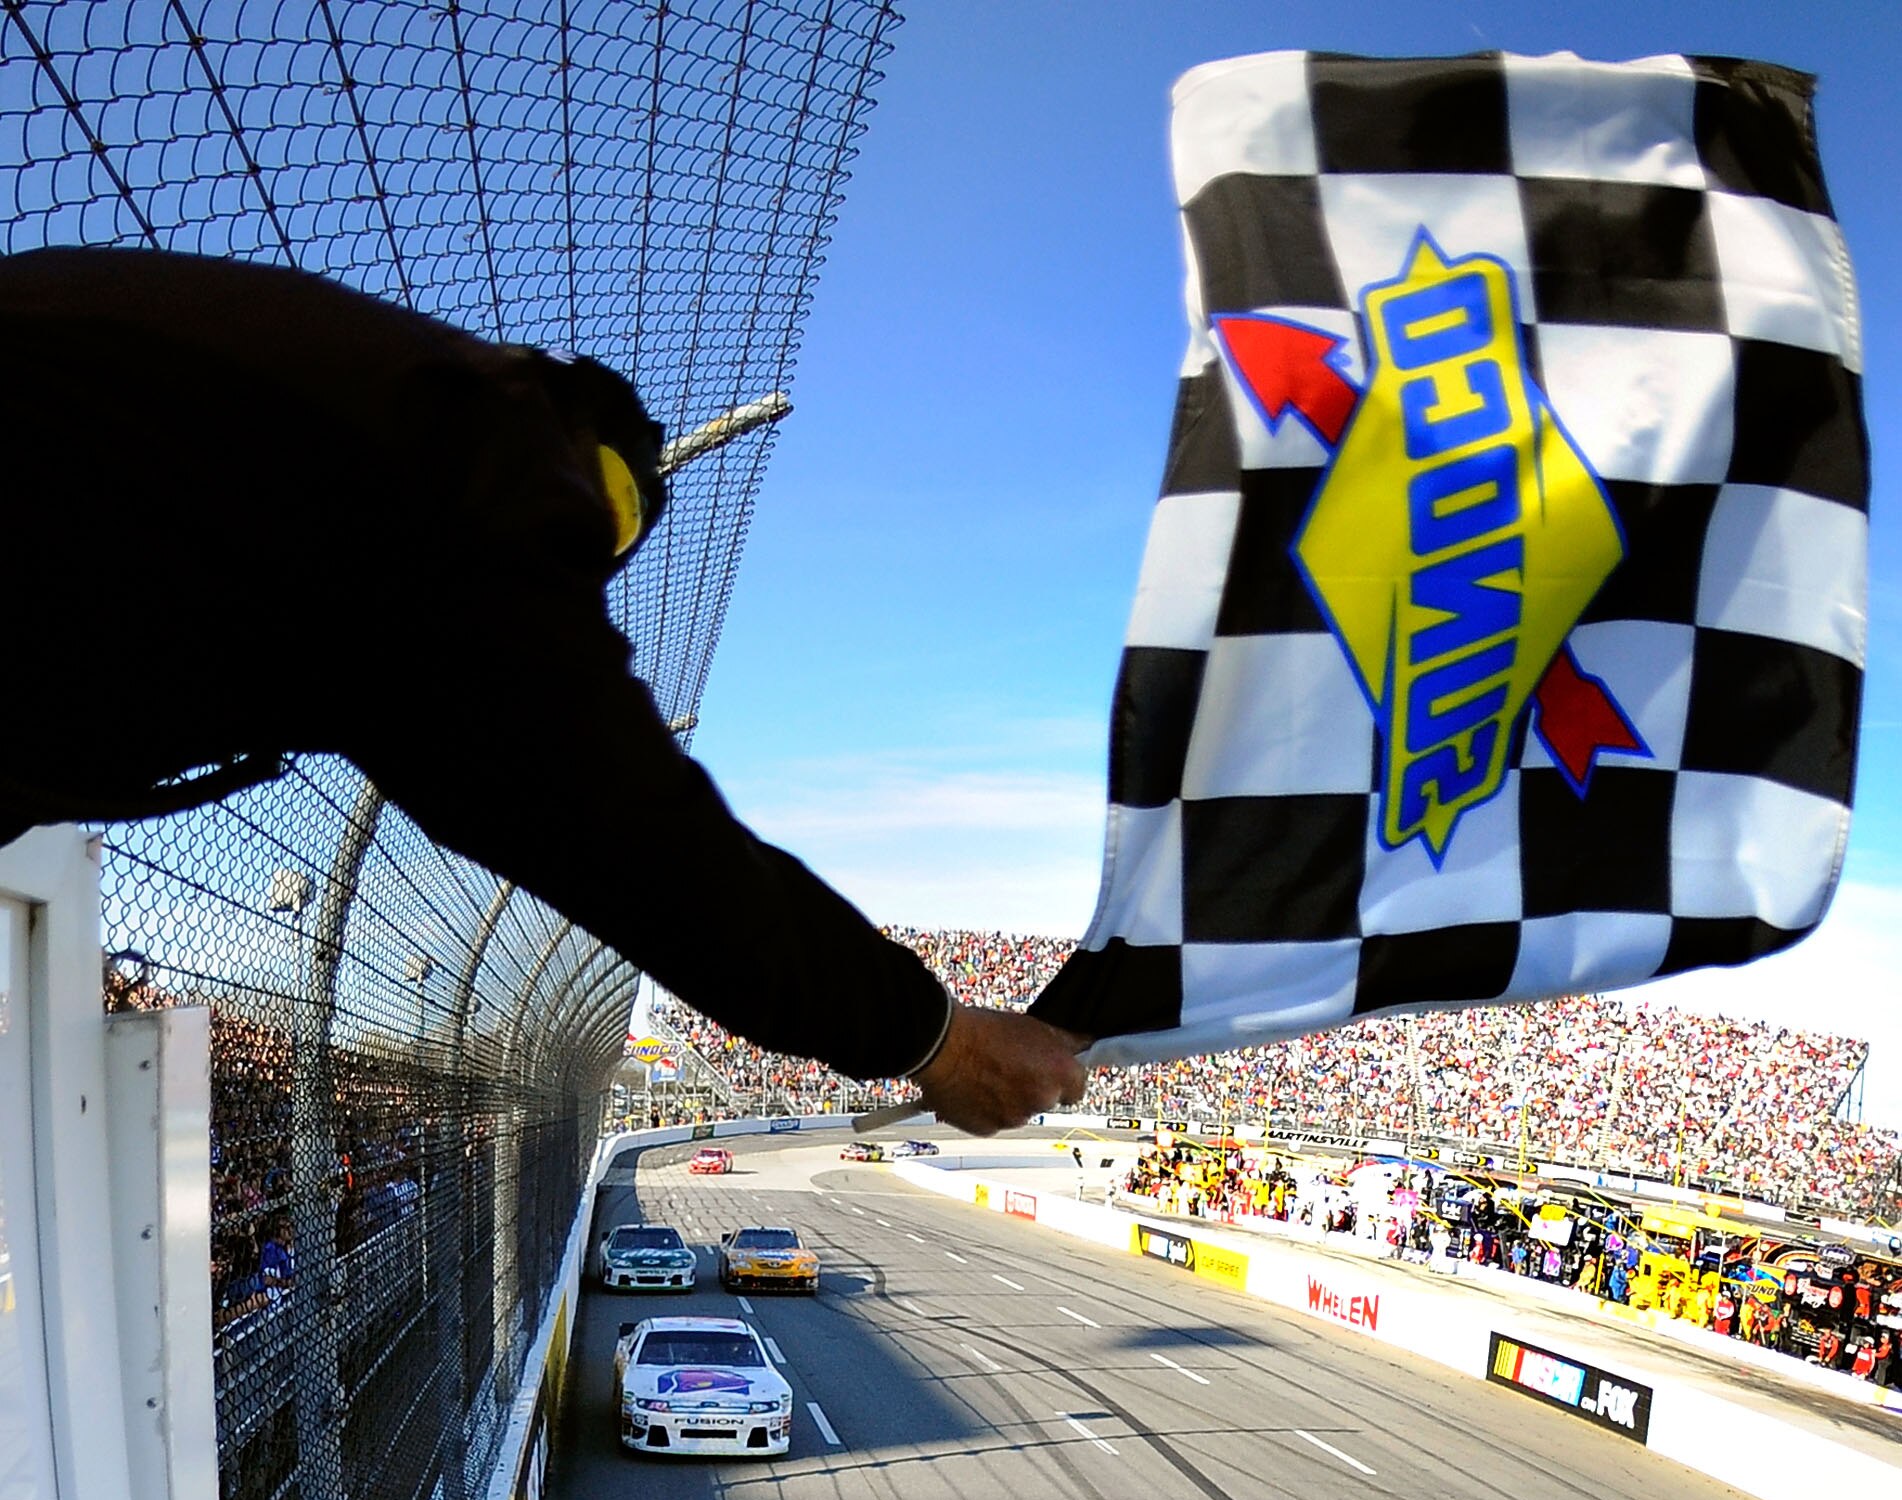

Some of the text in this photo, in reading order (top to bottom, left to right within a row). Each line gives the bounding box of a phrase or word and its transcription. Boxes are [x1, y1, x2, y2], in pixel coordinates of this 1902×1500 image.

[624, 1042, 680, 1057] SUNOCO
[1262, 1129, 1370, 1149] MARTINSVILLE
[1308, 1275, 1380, 1332] WHELEN
[1597, 1380, 1638, 1429] FOX
[674, 1417, 745, 1426] FUSION
